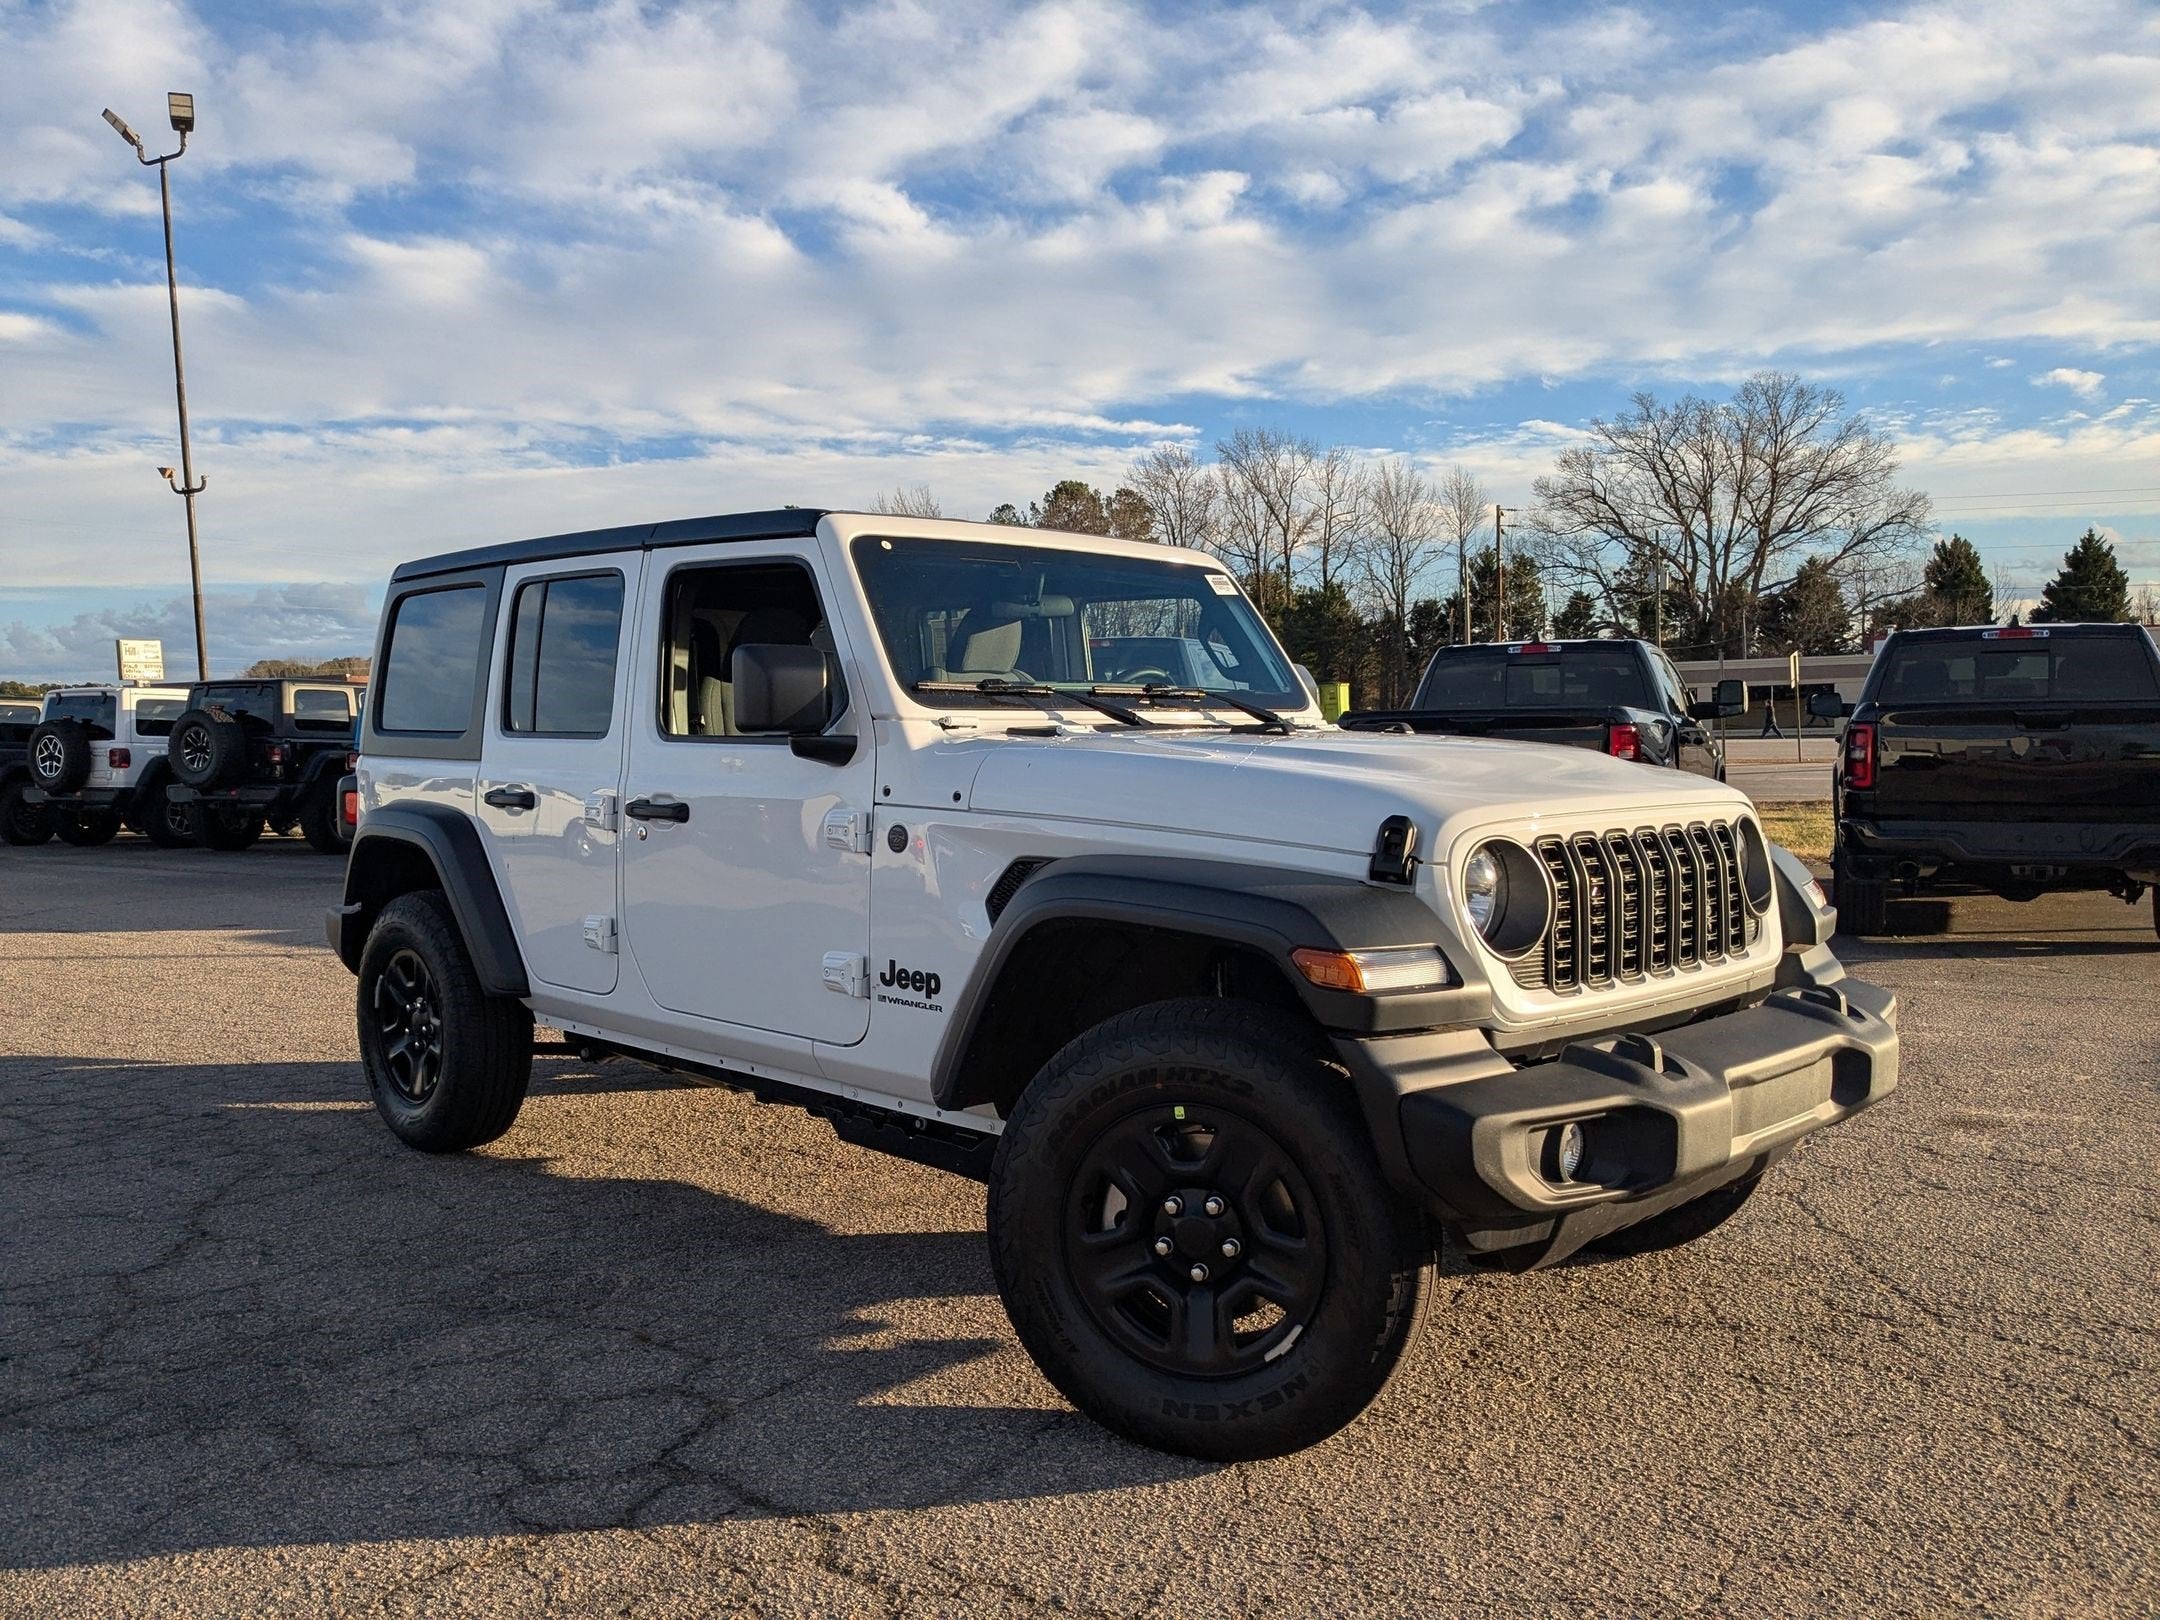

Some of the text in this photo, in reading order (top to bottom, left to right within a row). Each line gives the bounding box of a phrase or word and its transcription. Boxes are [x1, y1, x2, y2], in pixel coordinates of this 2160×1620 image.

[880, 959, 941, 999] Jeep
[887, 996, 943, 1013] WRANGLER
[1161, 1373, 1309, 1421] NEXEN
